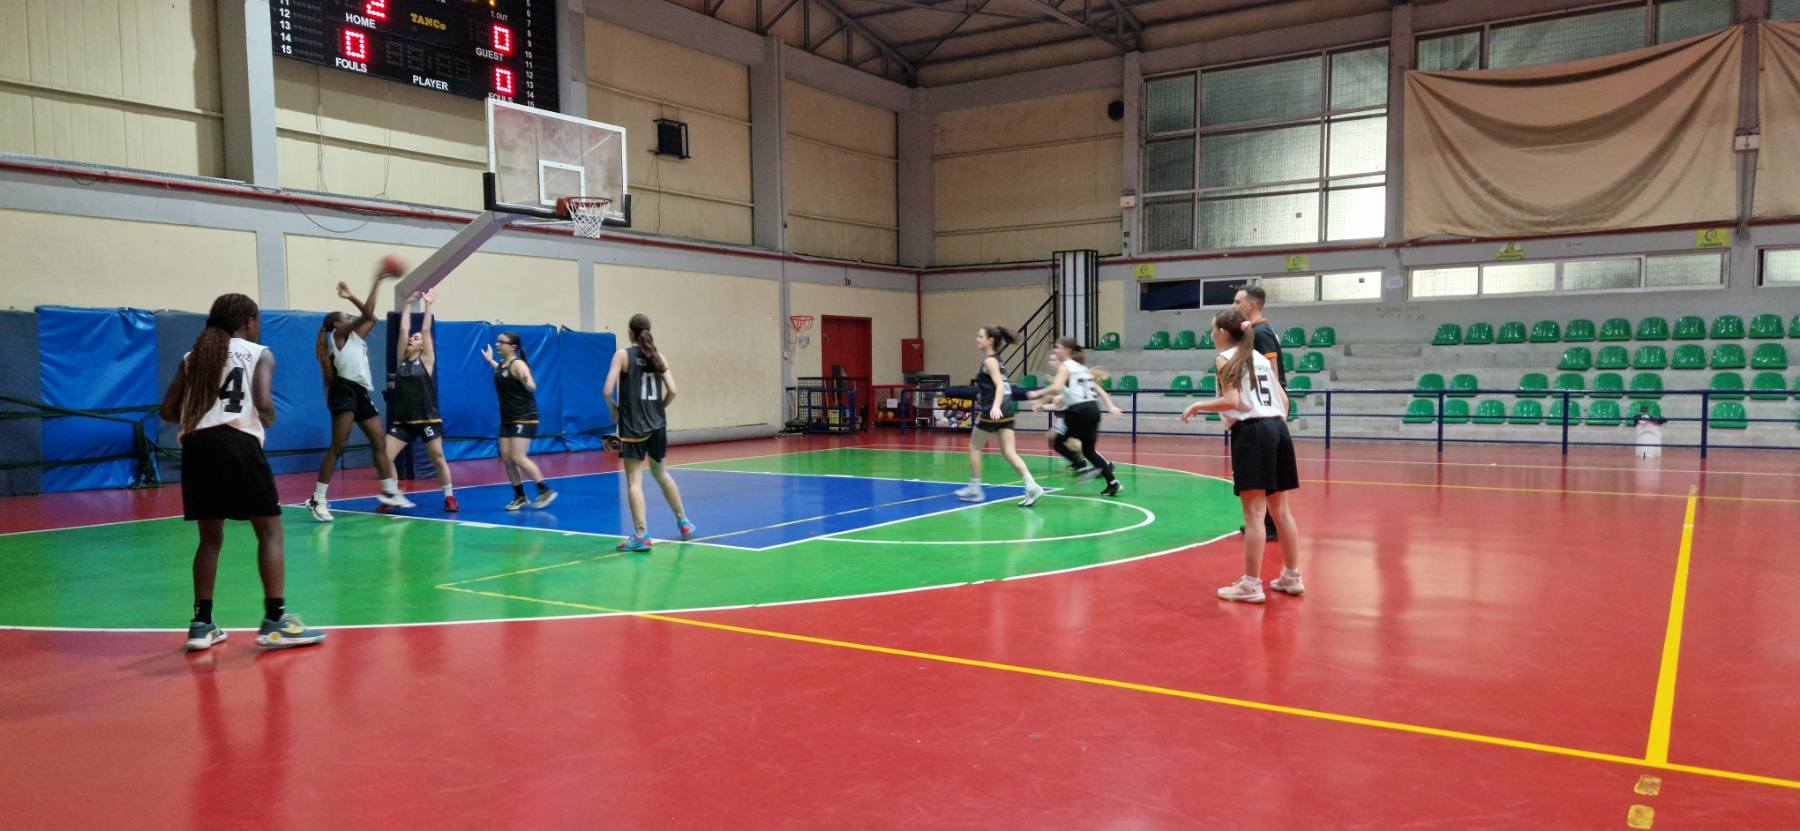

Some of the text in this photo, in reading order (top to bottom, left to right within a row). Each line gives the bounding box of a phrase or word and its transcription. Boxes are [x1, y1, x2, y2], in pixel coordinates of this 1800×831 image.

[279, 8, 291, 19] 12
[496, 13, 508, 21] OUT
[279, 20, 291, 30] 13
[345, 12, 376, 29] HOME
[280, 32, 292, 43] 14
[494, 25, 510, 51] 0
[280, 44, 292, 55] 15
[344, 30, 365, 59] 0
[475, 47, 504, 62] GUEST
[335, 57, 368, 73] FOULS
[525, 61, 533, 69] 11
[495, 68, 512, 93] 0
[526, 71, 534, 79] 12
[412, 74, 449, 91] PLAYER
[526, 81, 534, 89] 13
[526, 91, 534, 99] 14
[218, 366, 245, 414] 4
[424, 425, 434, 437] 15
